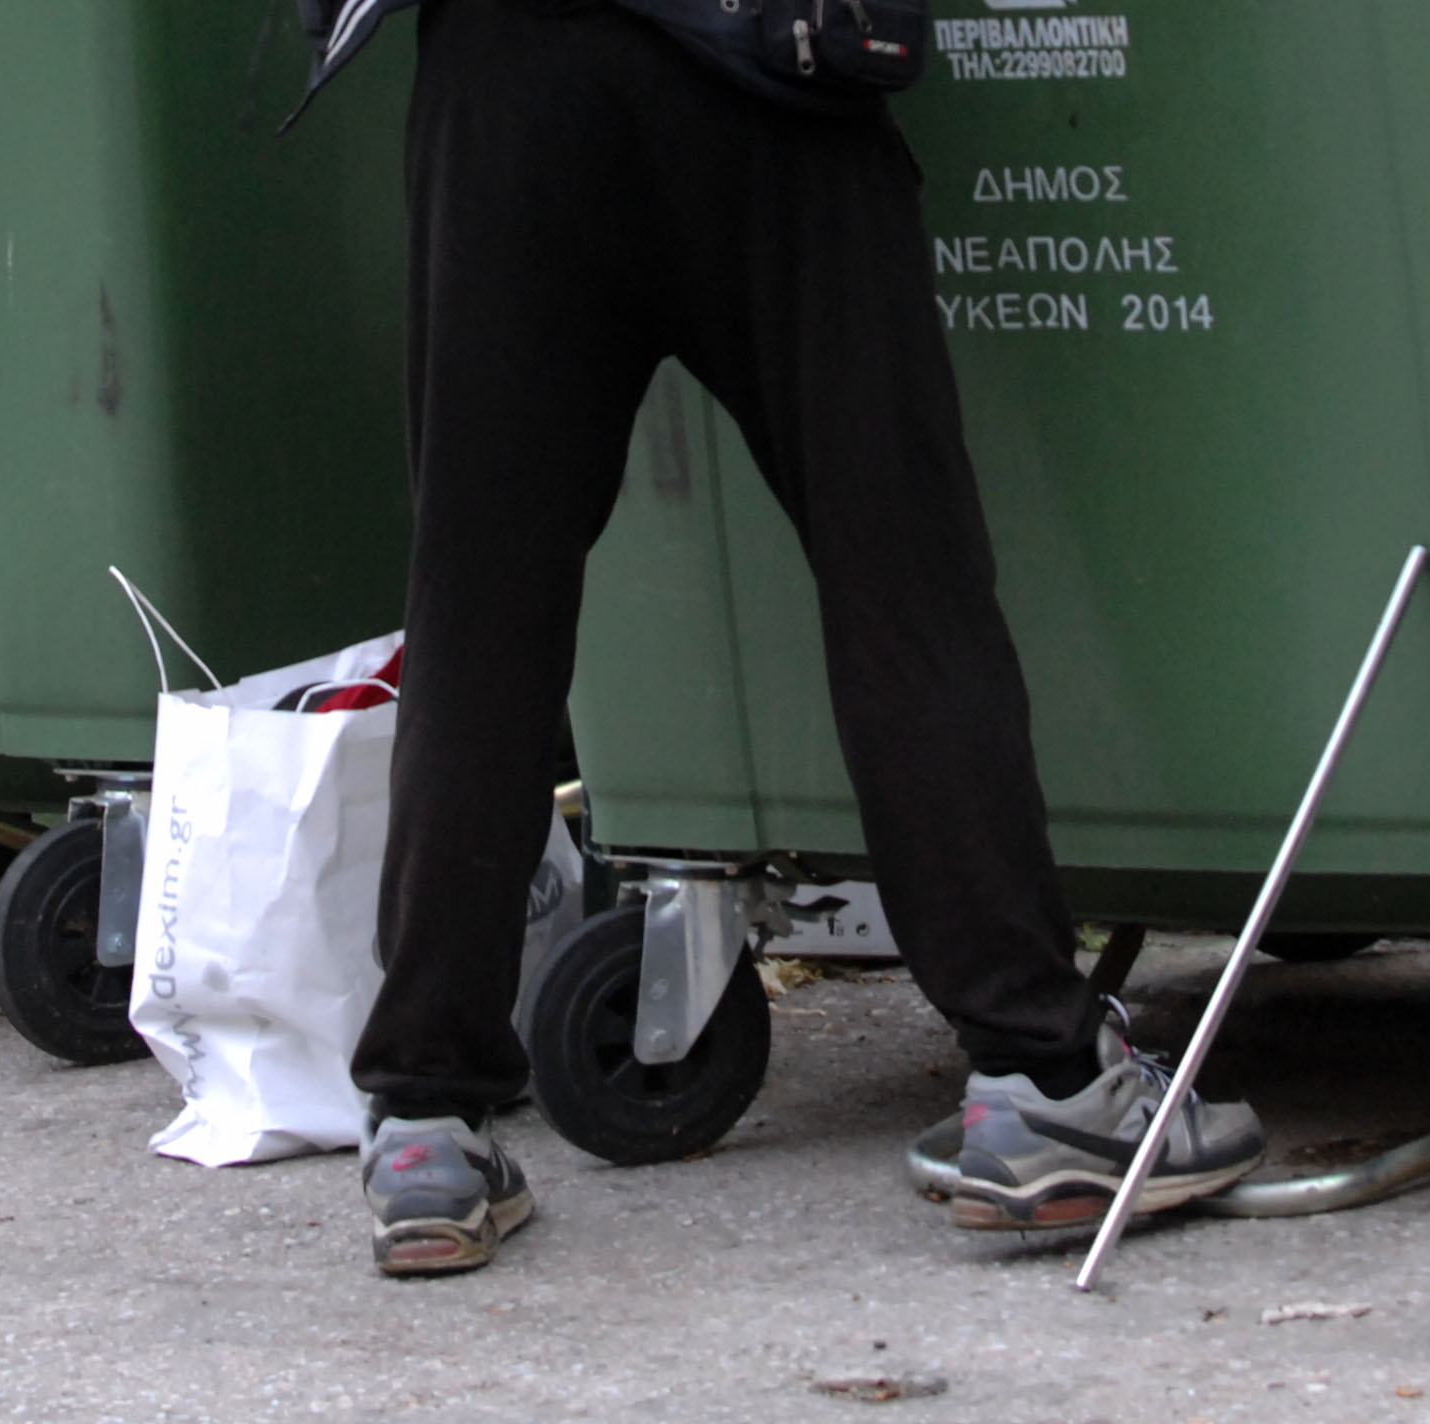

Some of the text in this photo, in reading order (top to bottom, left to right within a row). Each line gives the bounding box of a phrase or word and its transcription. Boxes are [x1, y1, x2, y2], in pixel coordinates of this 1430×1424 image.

[934, 15, 1130, 51] ΠΕΡΙΒΑΛΛΟΝΤΙΚΗ
[973, 165, 1129, 203] ΔΗΜΟΣ
[934, 236, 1180, 274] ΝΕΑΠΟΛΗΣ
[934, 292, 1215, 331] ΥΚΕΩΝ 2014
